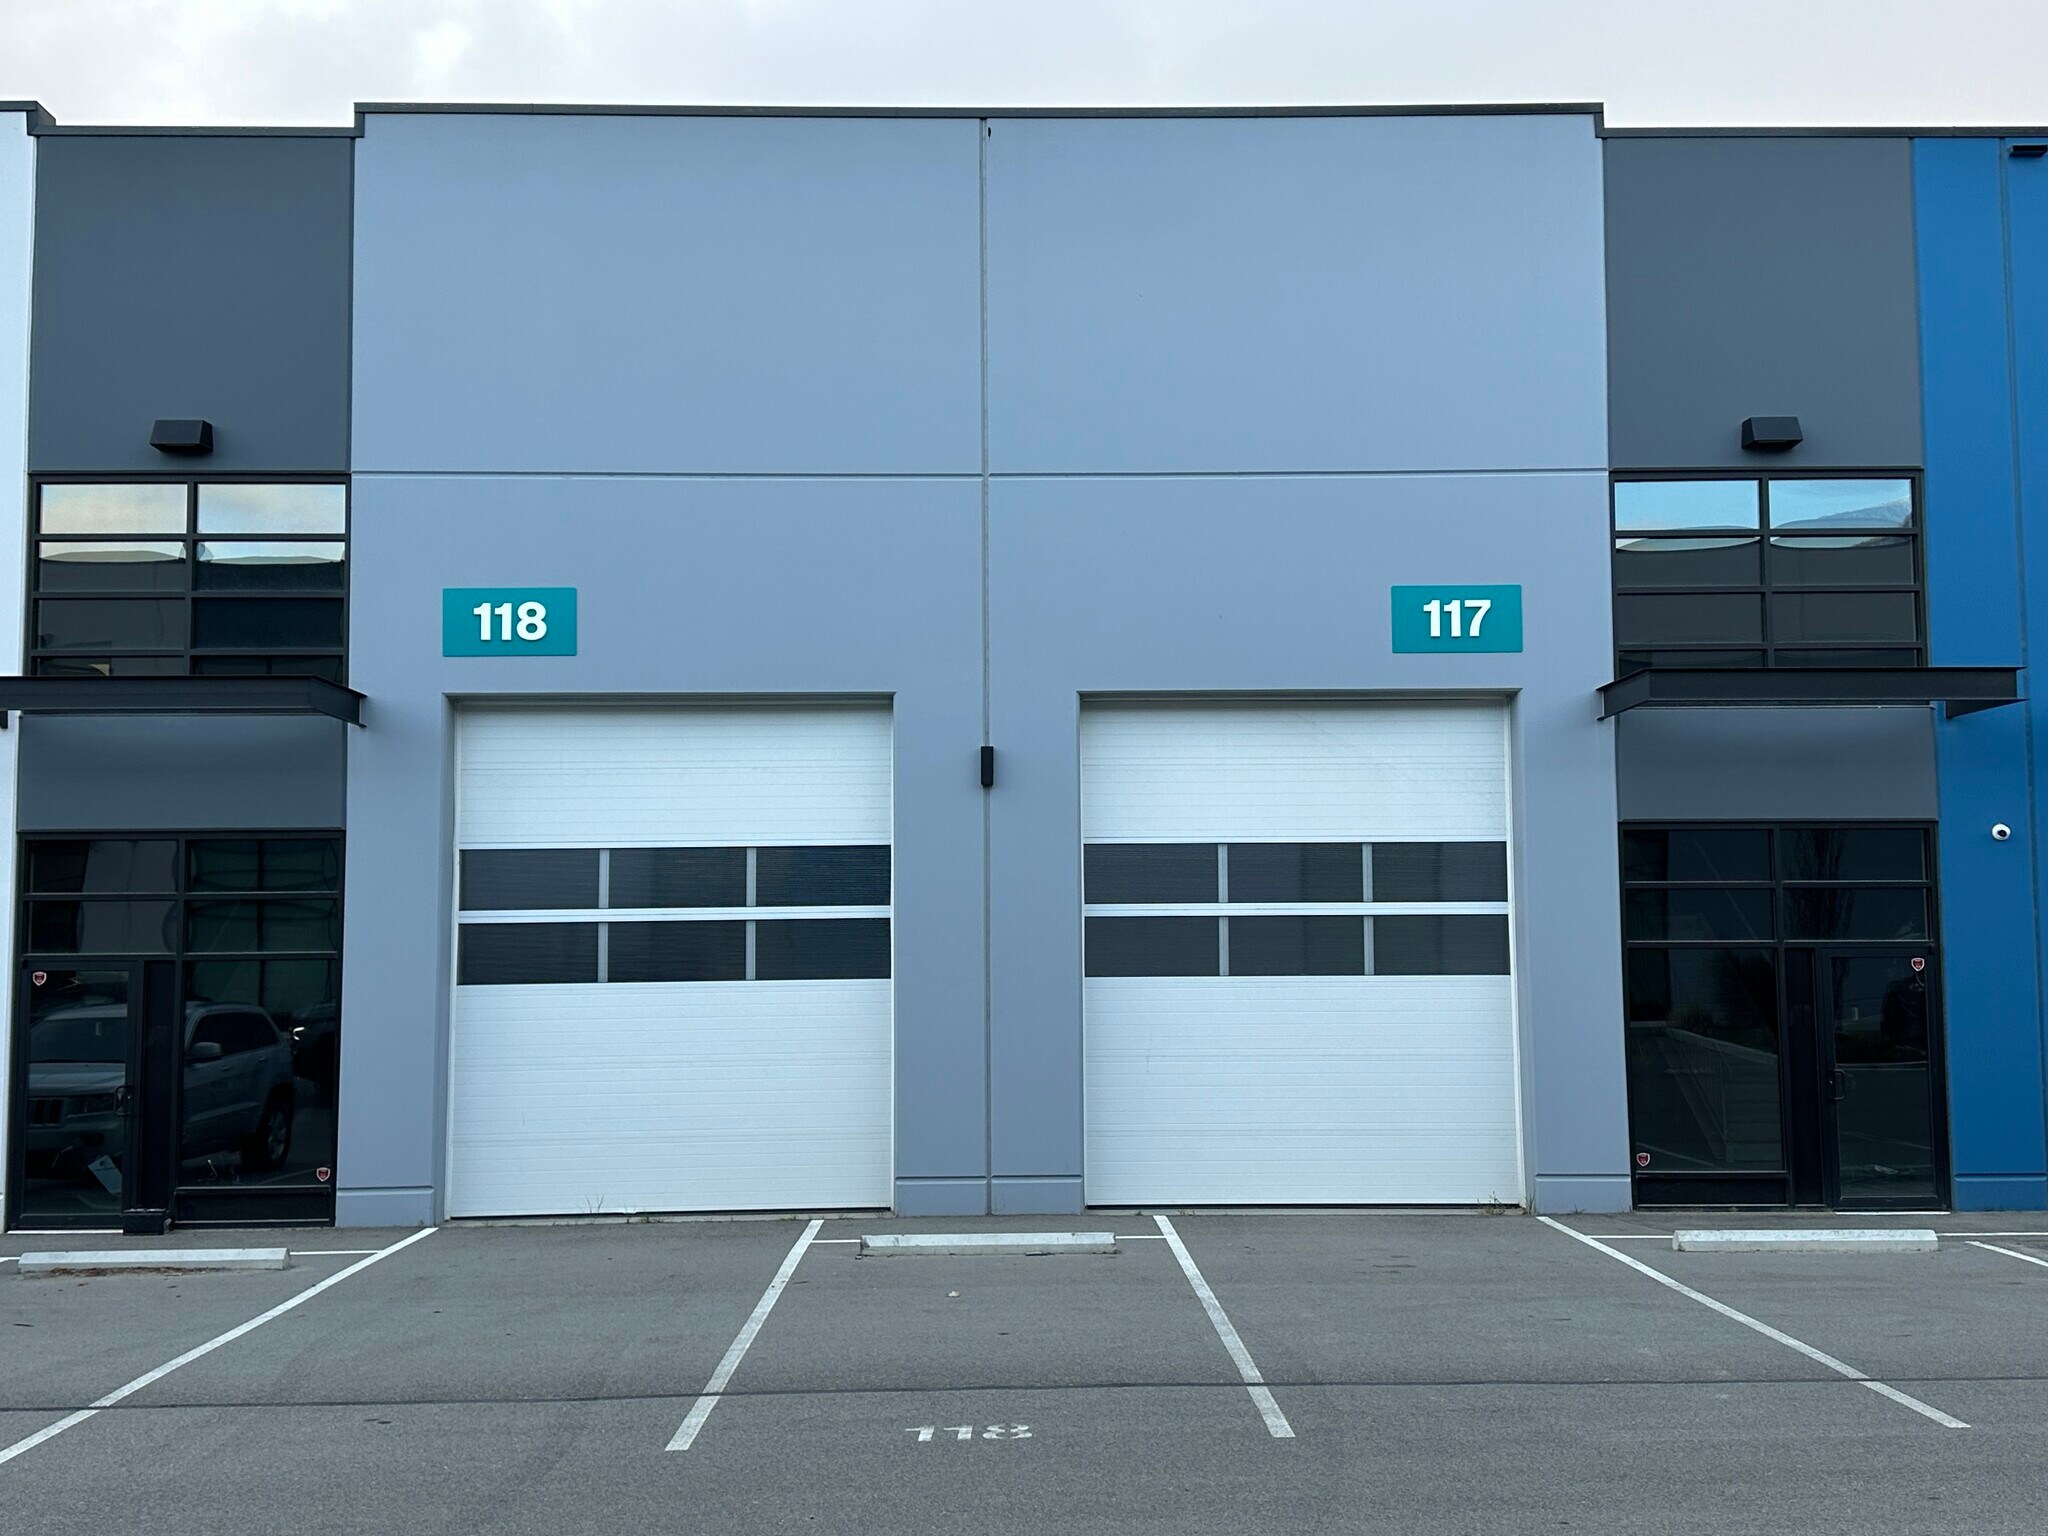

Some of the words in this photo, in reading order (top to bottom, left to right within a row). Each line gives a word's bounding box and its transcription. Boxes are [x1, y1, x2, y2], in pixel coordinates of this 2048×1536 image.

[473, 601, 547, 641] 118
[1423, 599, 1491, 637] 117
[905, 1423, 1033, 1442] 118
